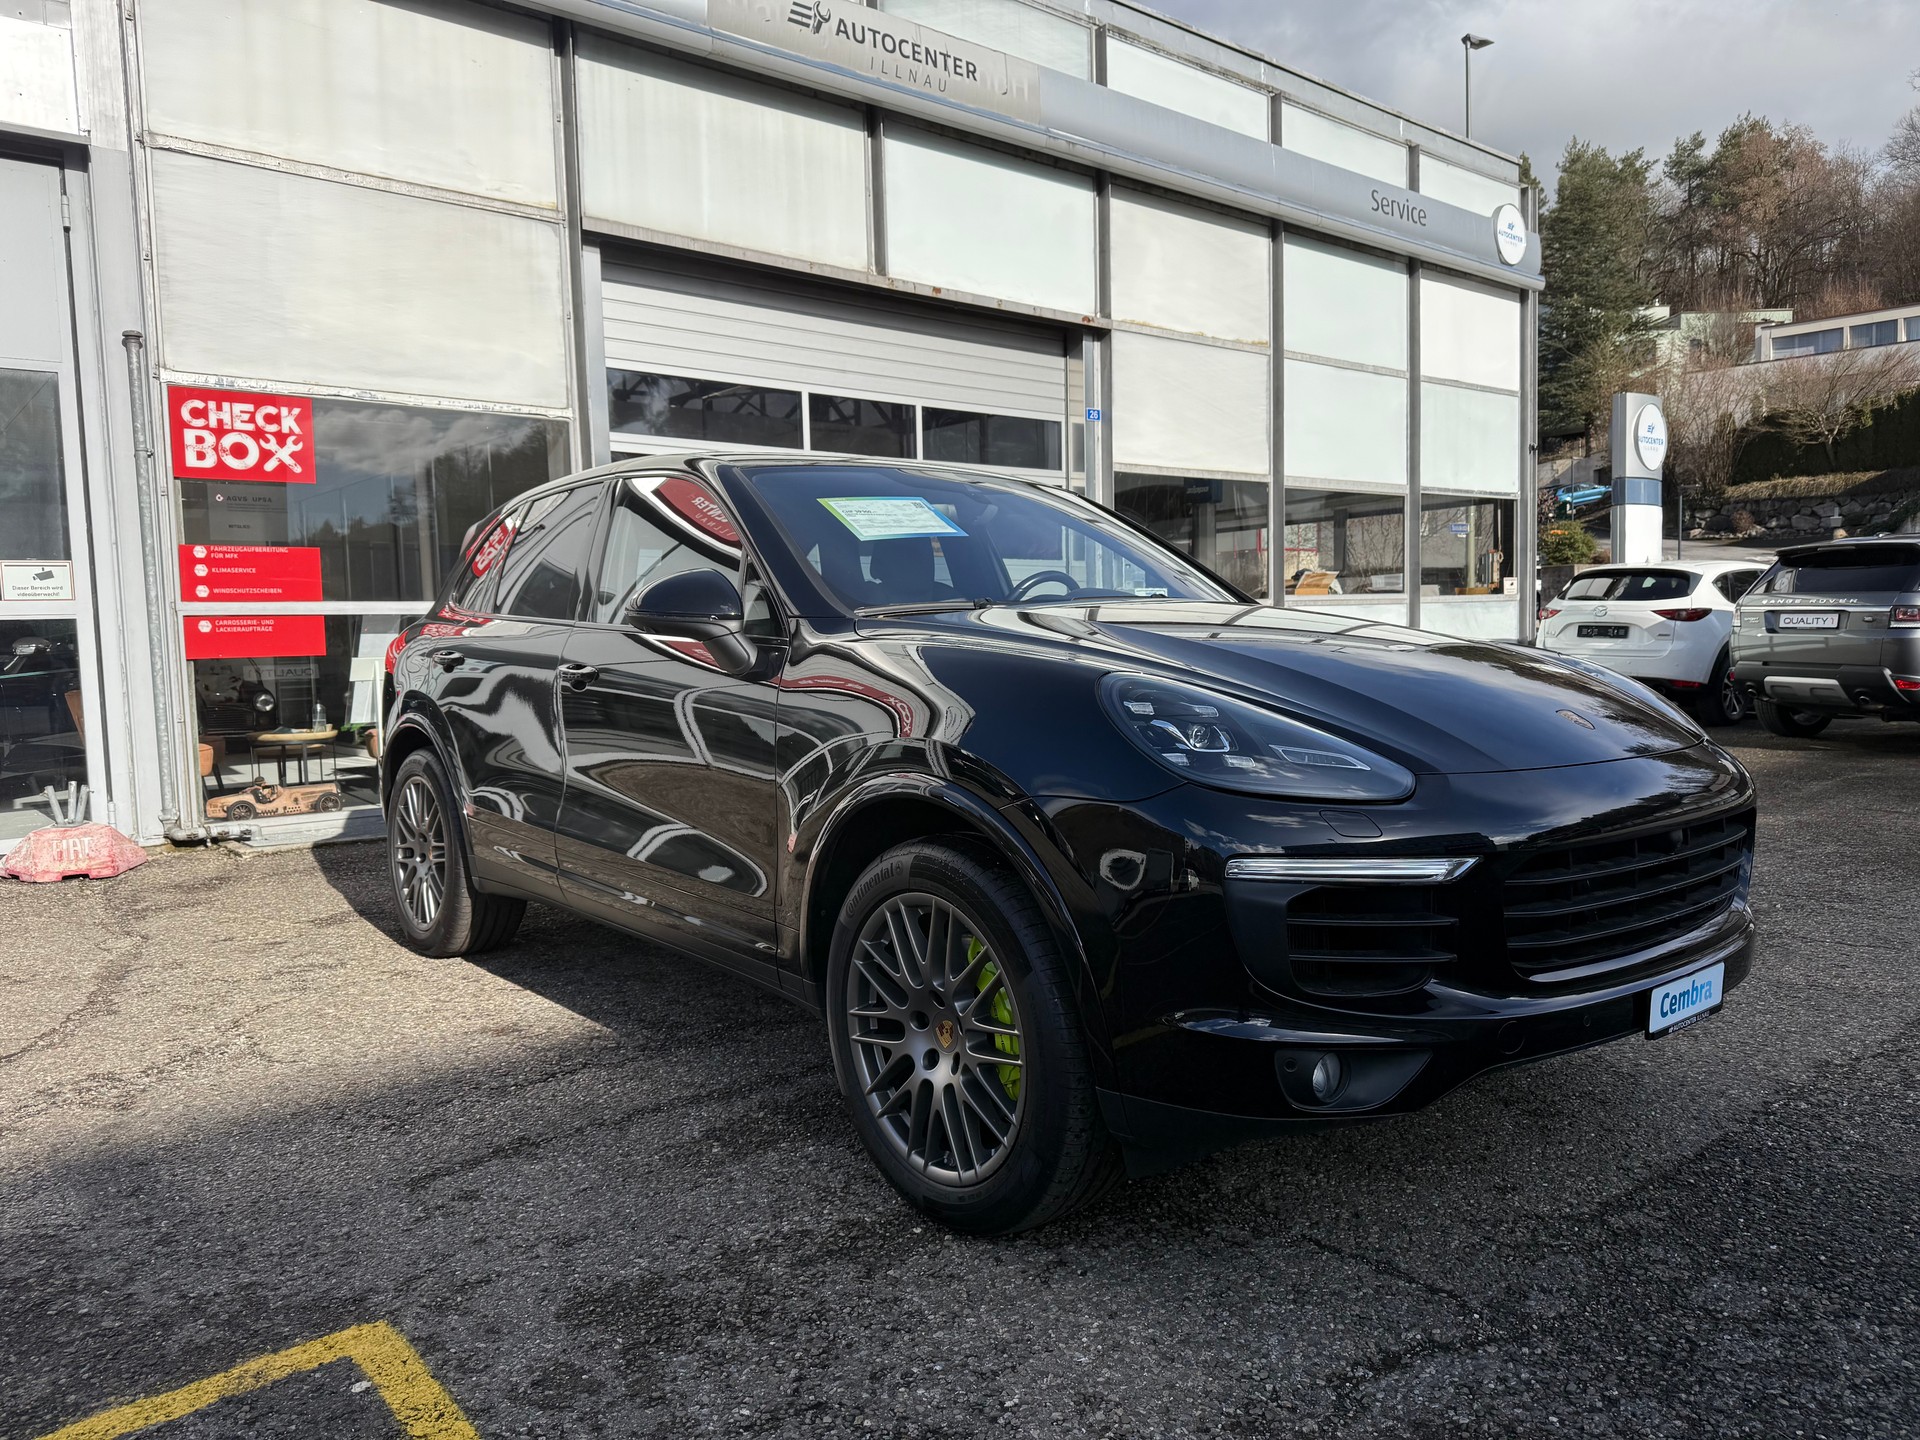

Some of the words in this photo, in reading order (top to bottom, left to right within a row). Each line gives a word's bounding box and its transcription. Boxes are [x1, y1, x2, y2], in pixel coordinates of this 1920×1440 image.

[835, 17, 978, 82] AUTOCENTER
[870, 56, 948, 93] ILLNAU
[1371, 189, 1427, 227] Service
[180, 399, 303, 435] CHECK
[1089, 410, 1099, 419] 26
[183, 428, 304, 474] BOX
[210, 545, 289, 553] FAHRZEUGAUFBEREITUNG
[1783, 617, 1829, 625] QUALITY
[845, 862, 895, 918] Continental
[1660, 979, 1712, 1018] Cembra
